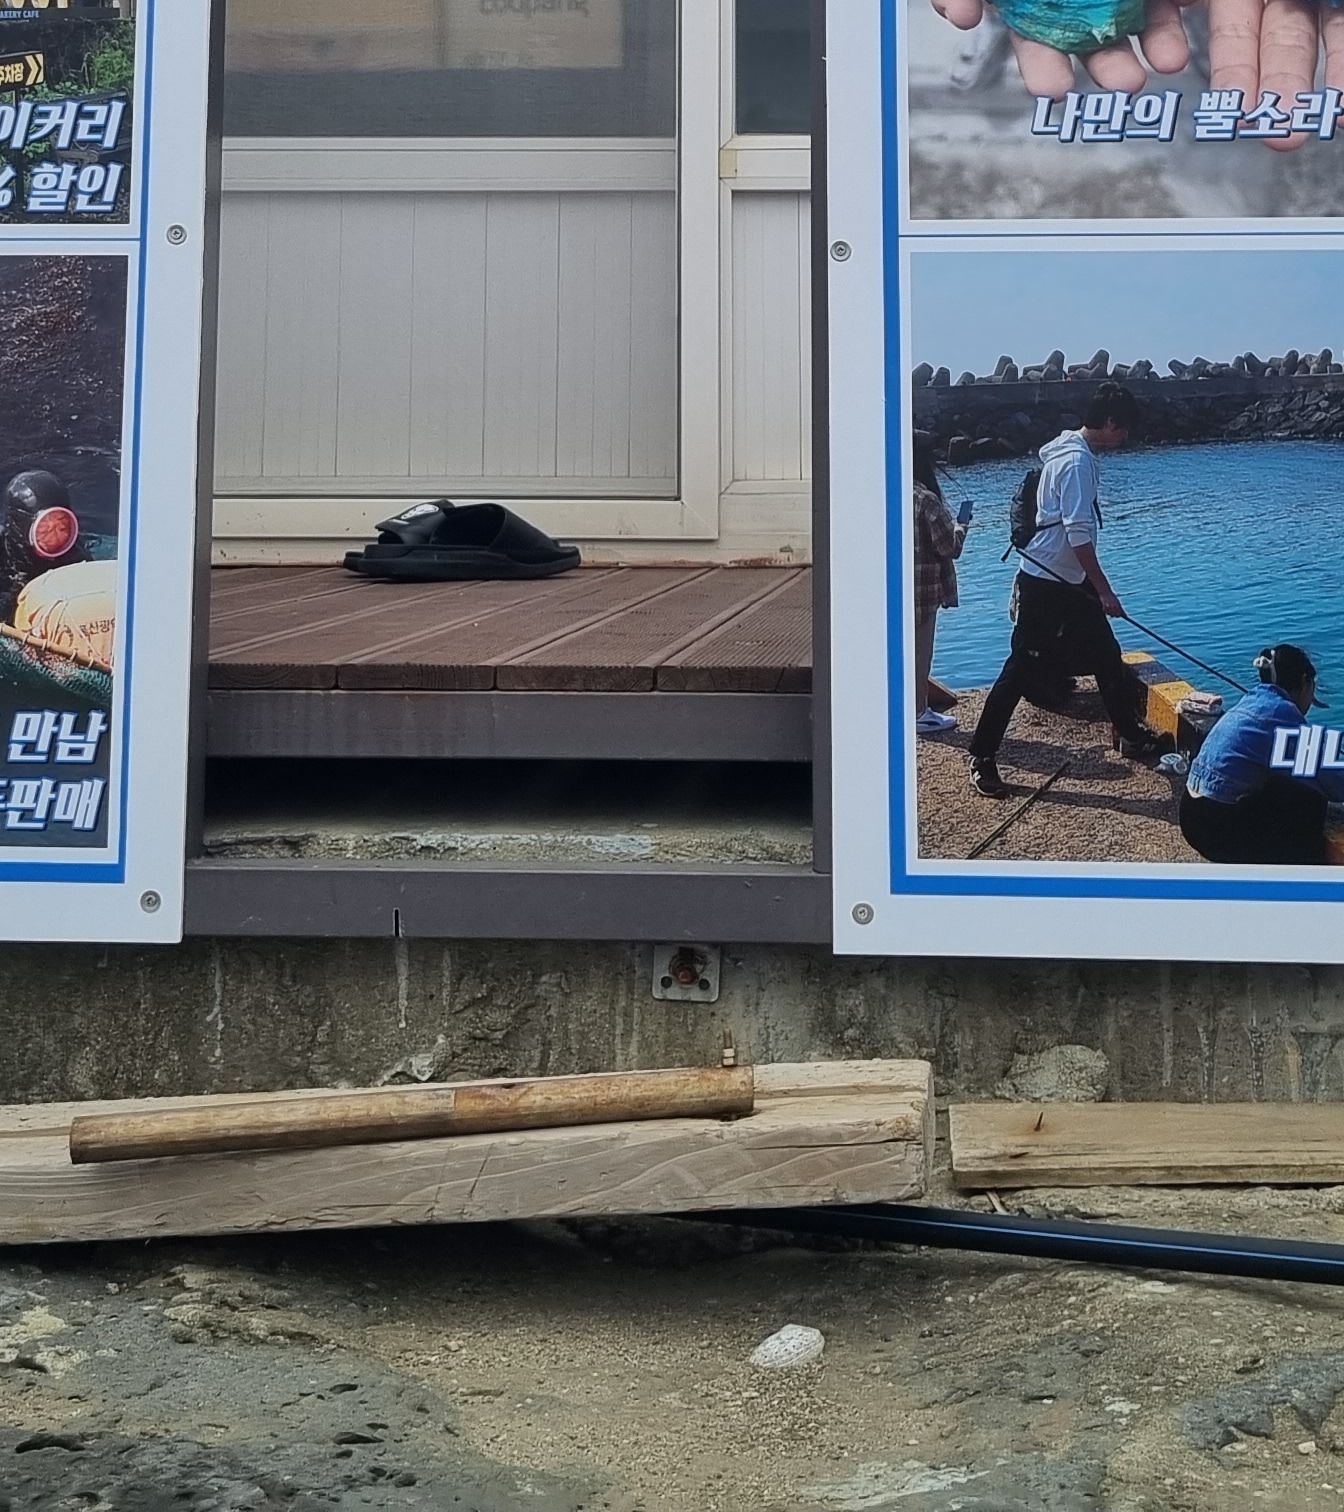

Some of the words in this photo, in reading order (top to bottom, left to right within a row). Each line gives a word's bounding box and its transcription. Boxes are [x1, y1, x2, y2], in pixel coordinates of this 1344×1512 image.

[22, 10, 40, 19] CAFE
[1030, 89, 1181, 143] 나만의
[1192, 86, 1344, 142] 뿔소라
[24, 161, 125, 213] 할인
[8, 710, 108, 764] 만남
